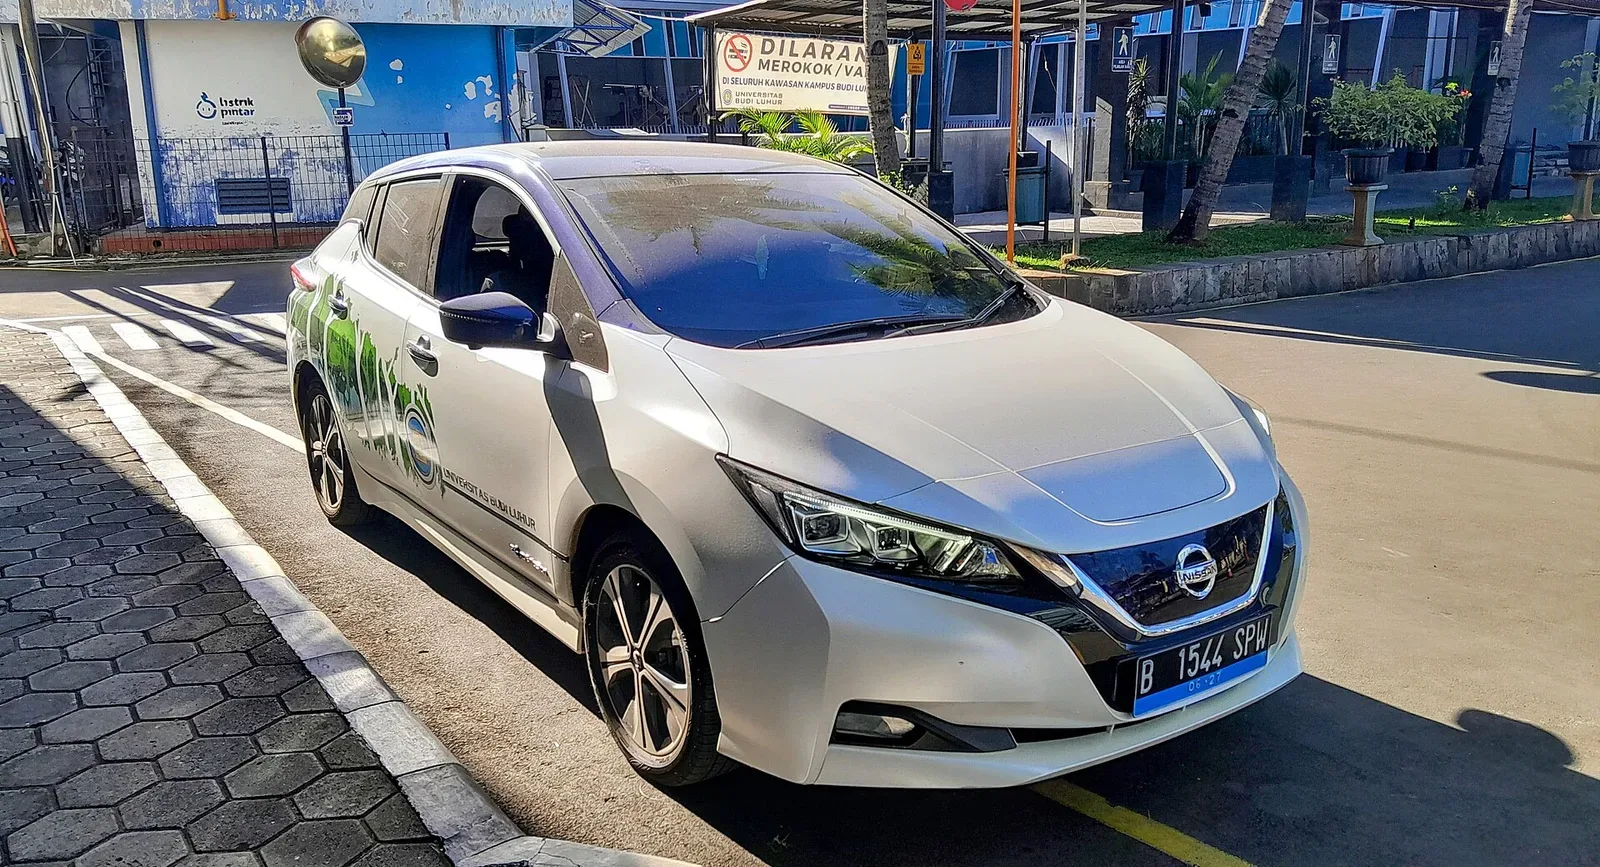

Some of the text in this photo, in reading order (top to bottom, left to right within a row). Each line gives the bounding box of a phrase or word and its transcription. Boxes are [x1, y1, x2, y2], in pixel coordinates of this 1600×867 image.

[760, 38, 866, 62] DILARAN
[758, 59, 867, 78] MEROKOK/VA
[722, 77, 867, 93] DI SELURUH KAWASAN KAMPUS BUDI LU
[219, 97, 254, 106] listrik
[735, 91, 783, 99] UNIVERSITAS
[221, 108, 255, 118] pintar
[443, 467, 536, 531] UNIVERSITAS BUDI LUHUR
[1183, 565, 1217, 582] NISSAN
[1140, 618, 1269, 695] B 1544 SPW
